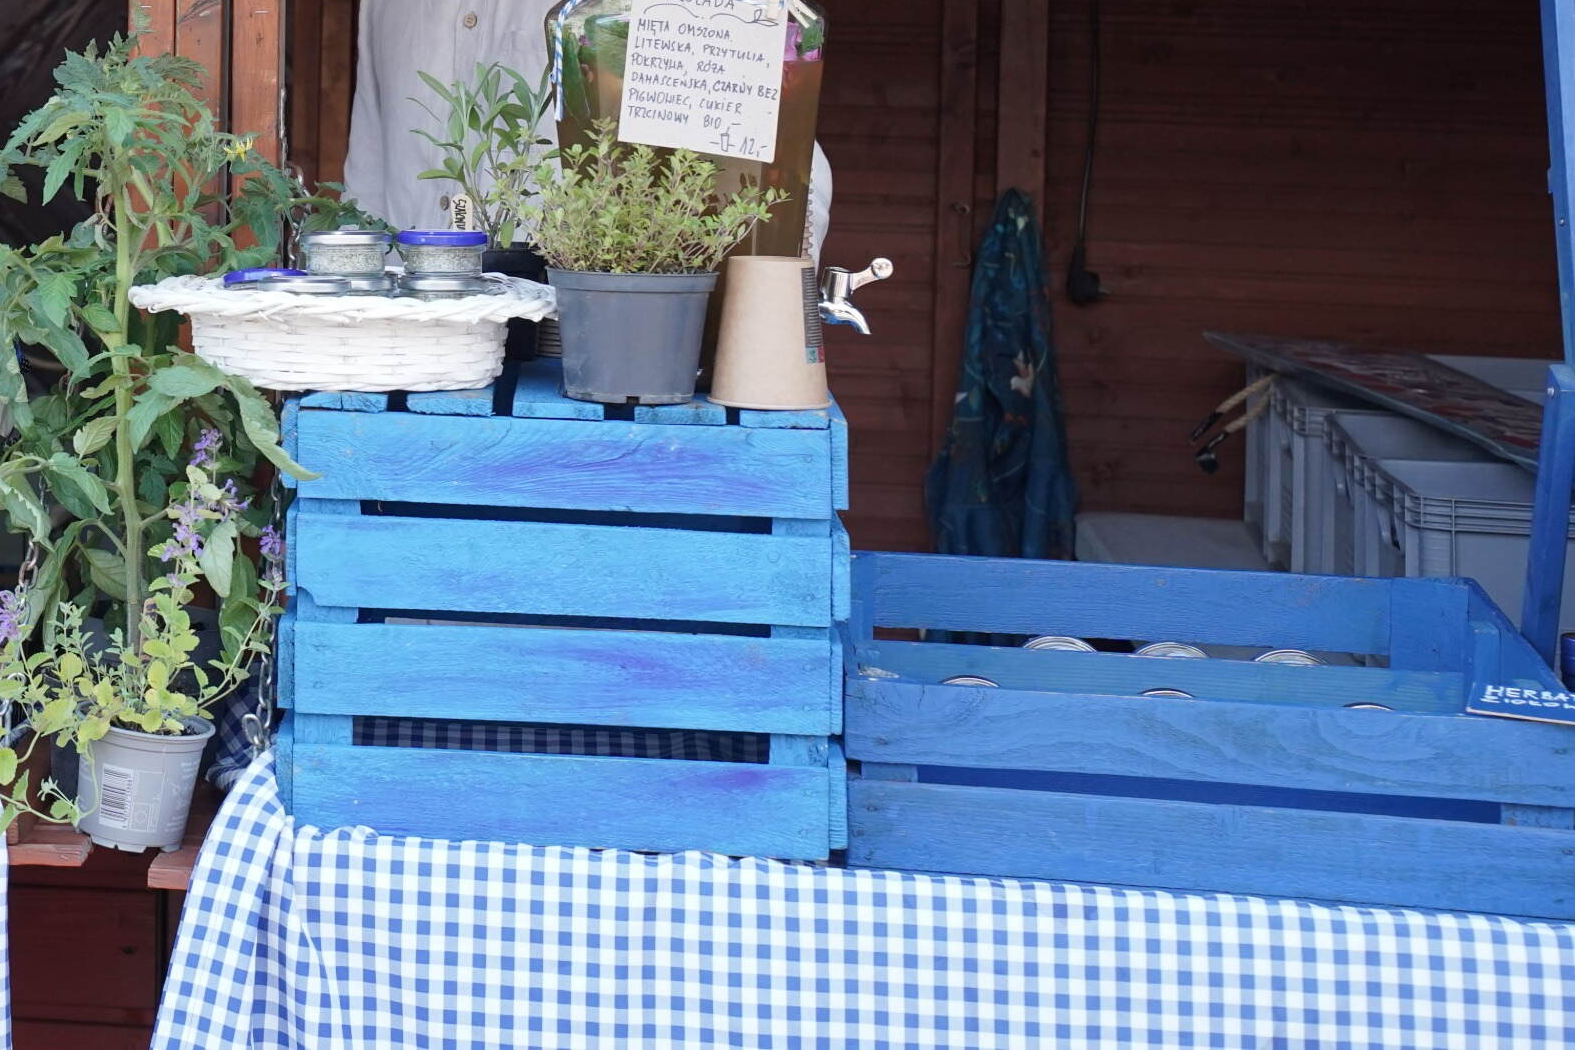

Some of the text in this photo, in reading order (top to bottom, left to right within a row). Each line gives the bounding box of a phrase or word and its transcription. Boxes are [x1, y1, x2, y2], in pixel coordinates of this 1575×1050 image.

[637, 18, 670, 35] MIĘTA
[757, 87, 778, 101] BEZ
[699, 98, 743, 114] CUKIER
[627, 105, 722, 129] TRZCINOWY BIO
